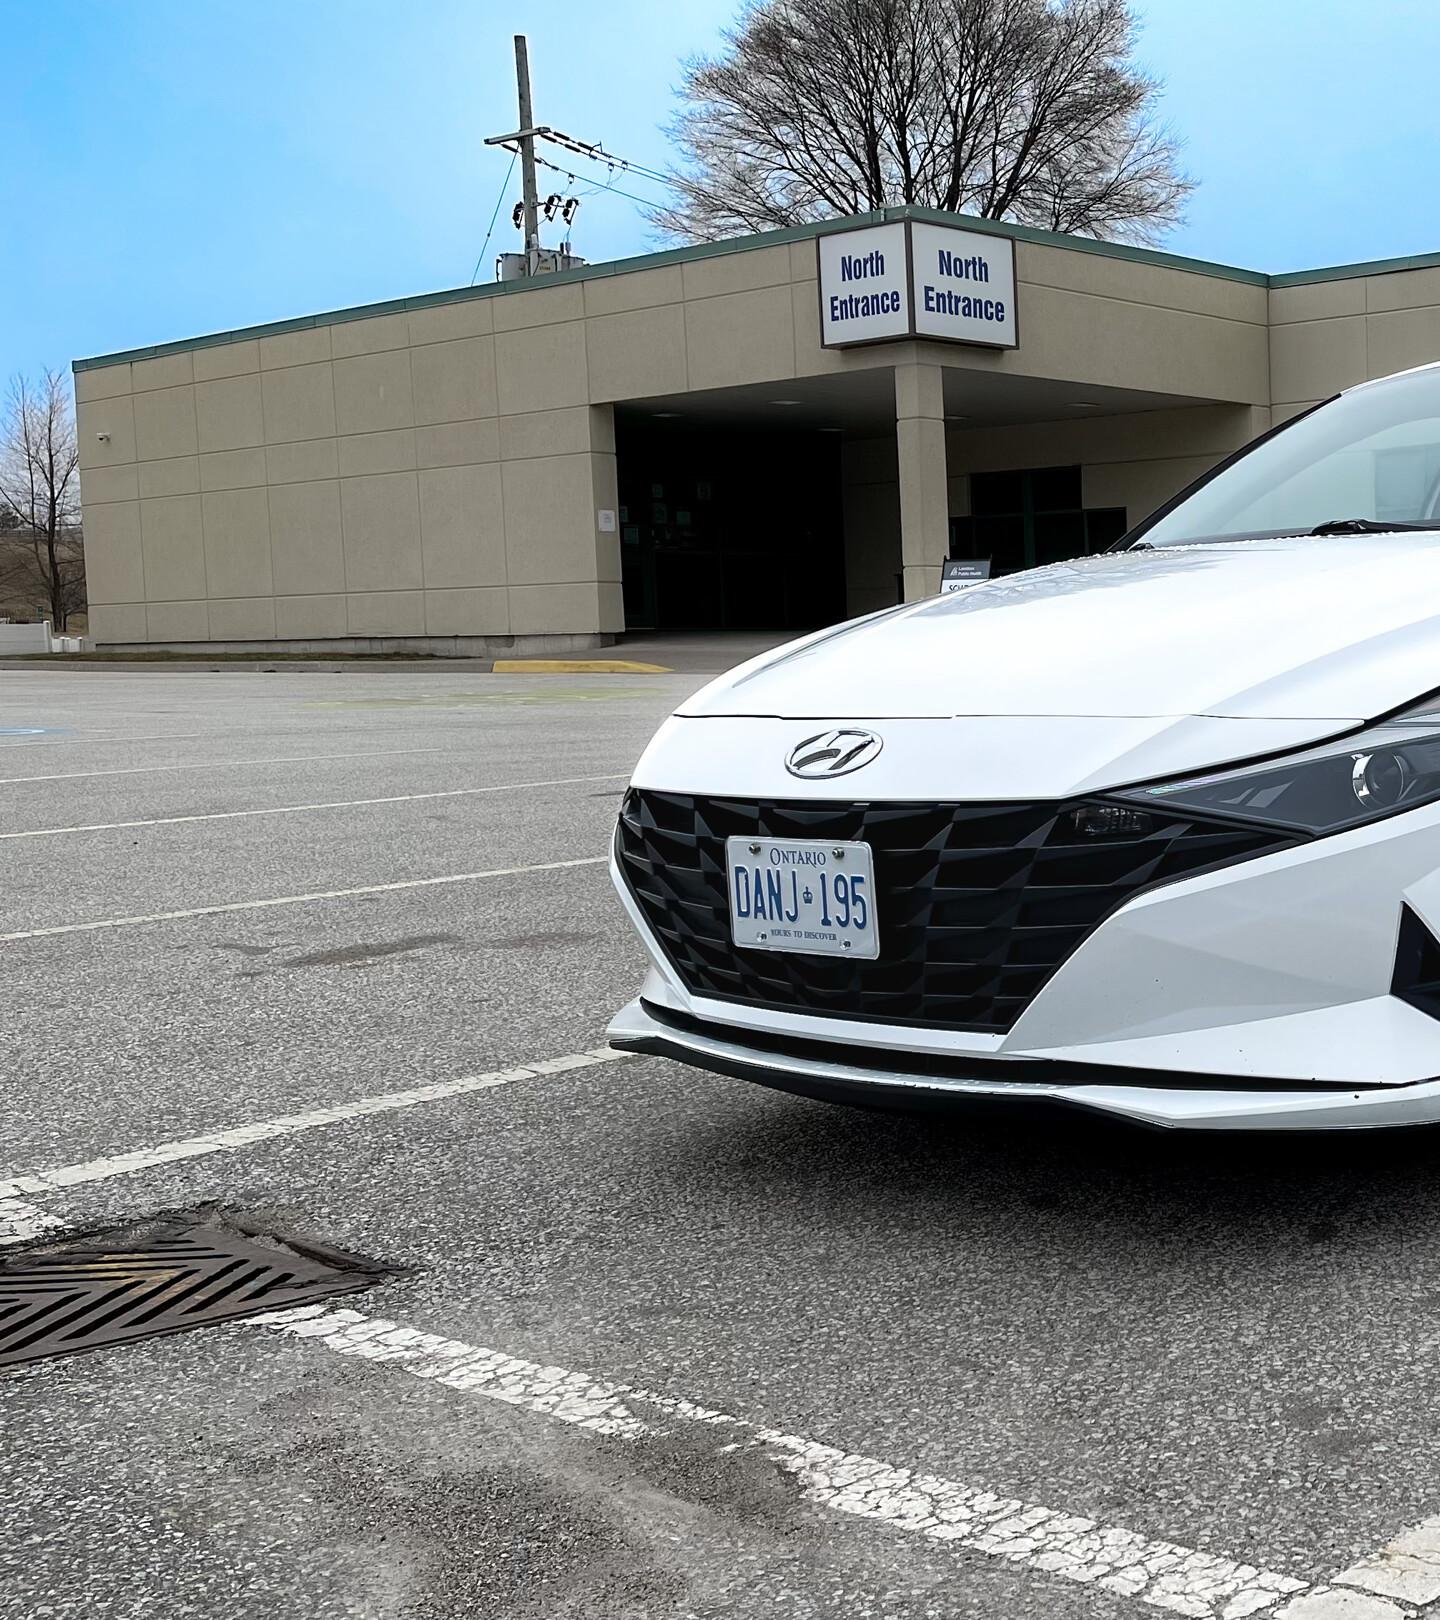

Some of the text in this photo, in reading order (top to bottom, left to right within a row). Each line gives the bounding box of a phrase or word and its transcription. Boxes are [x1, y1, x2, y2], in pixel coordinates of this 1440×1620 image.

[841, 250, 885, 282] North
[938, 249, 989, 283] North
[830, 290, 900, 322] Entrance
[924, 285, 1005, 322] Entrance
[734, 866, 867, 930] DANJ 195
[770, 929, 792, 937] YOURS
[804, 931, 837, 940] DISCOVER
